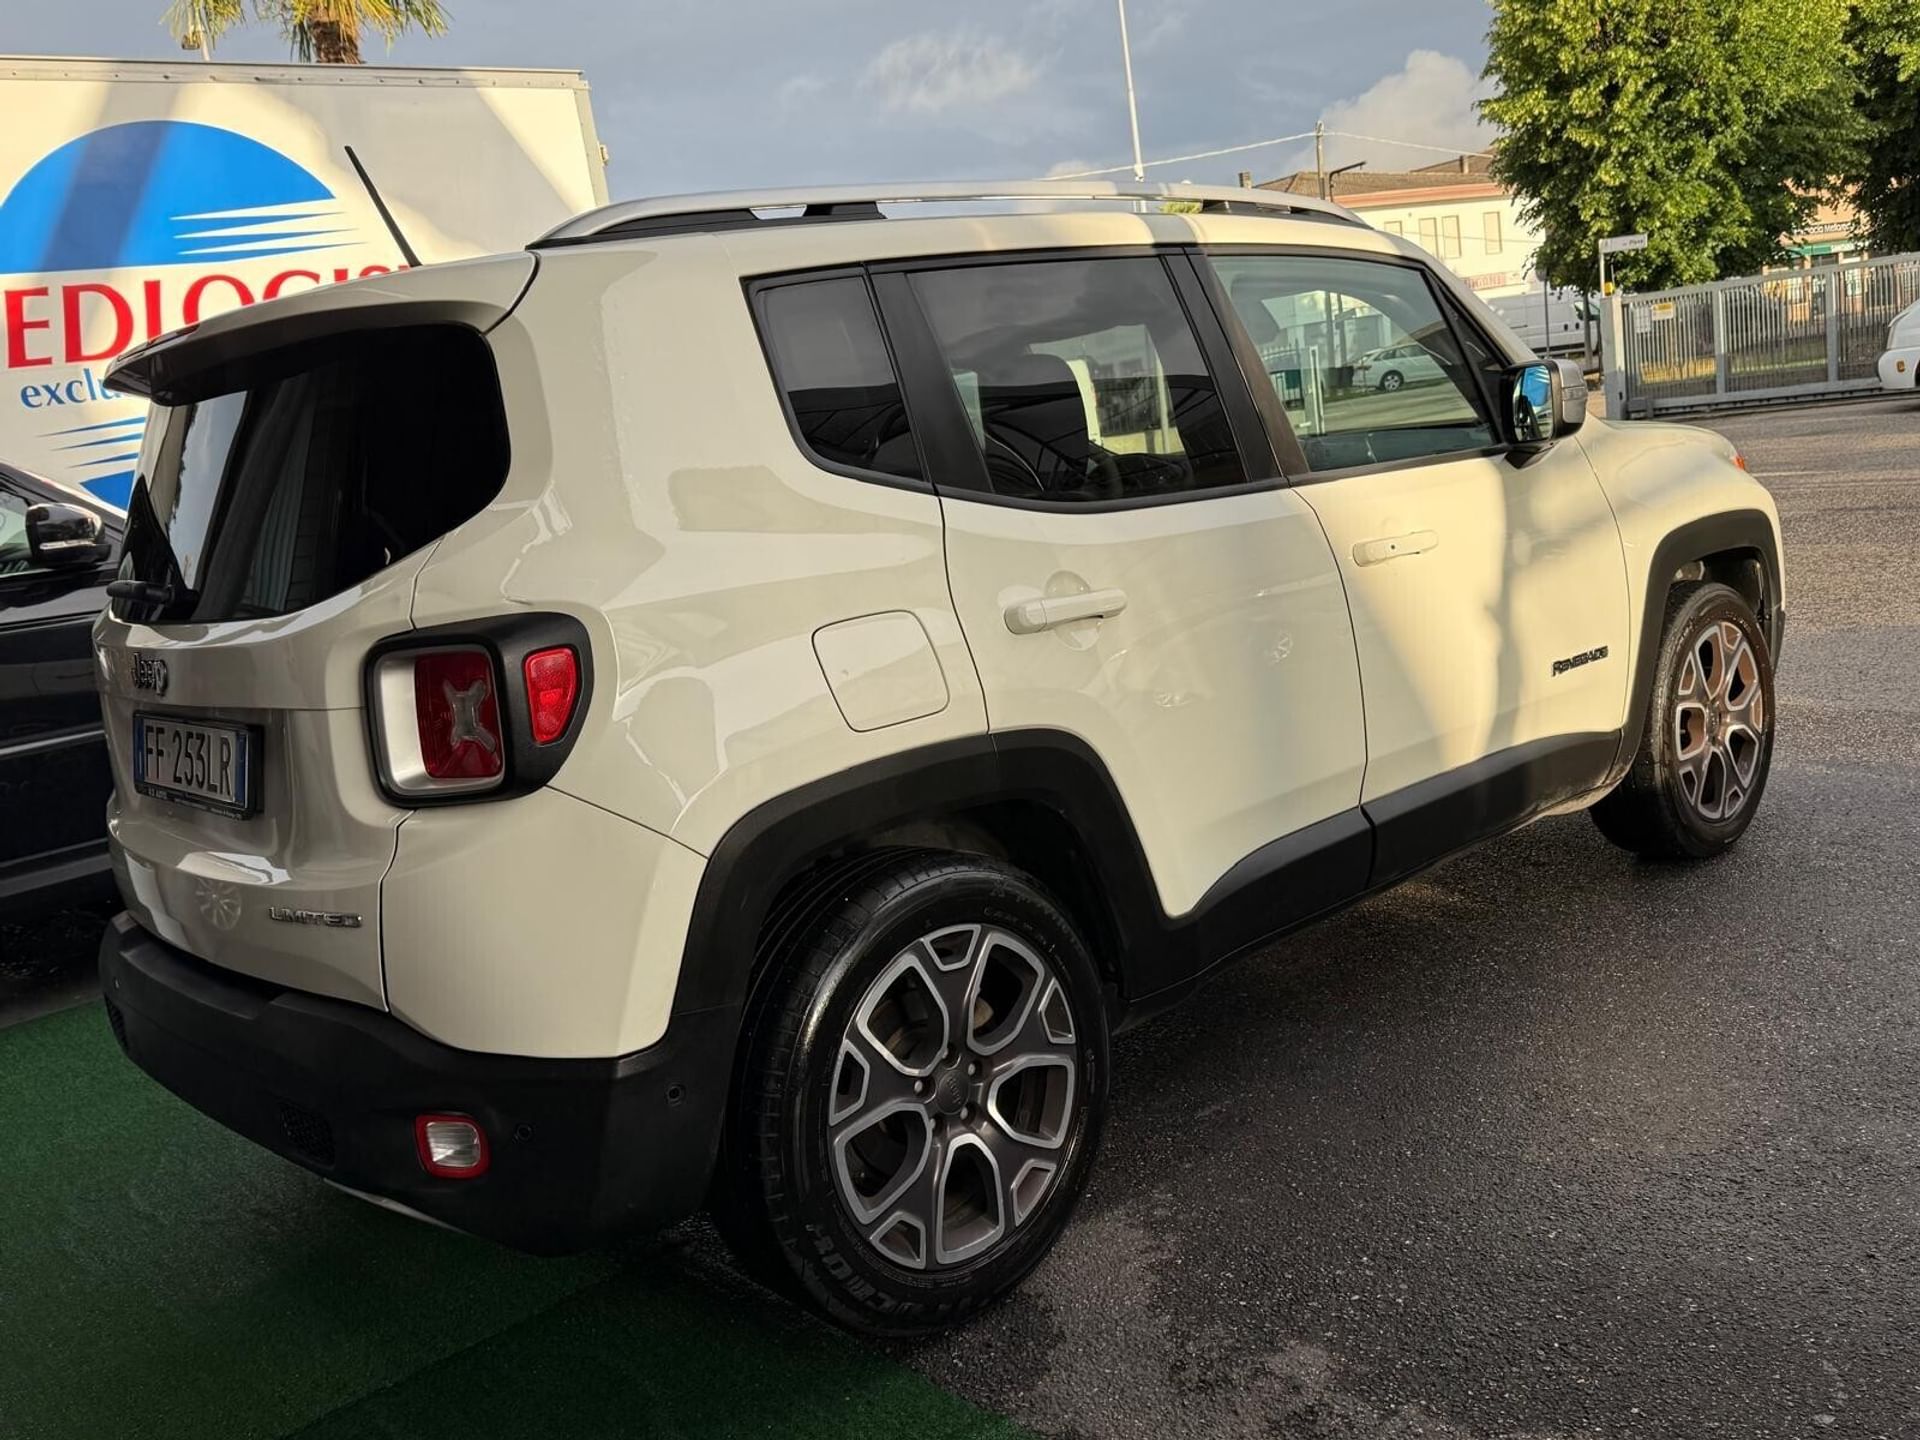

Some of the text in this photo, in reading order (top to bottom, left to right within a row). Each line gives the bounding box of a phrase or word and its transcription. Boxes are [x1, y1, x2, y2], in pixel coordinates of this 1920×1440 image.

[131, 652, 169, 697] Jeep
[145, 725, 165, 780] FF
[173, 730, 232, 797] 253LR
[267, 906, 362, 928] LIMITED
